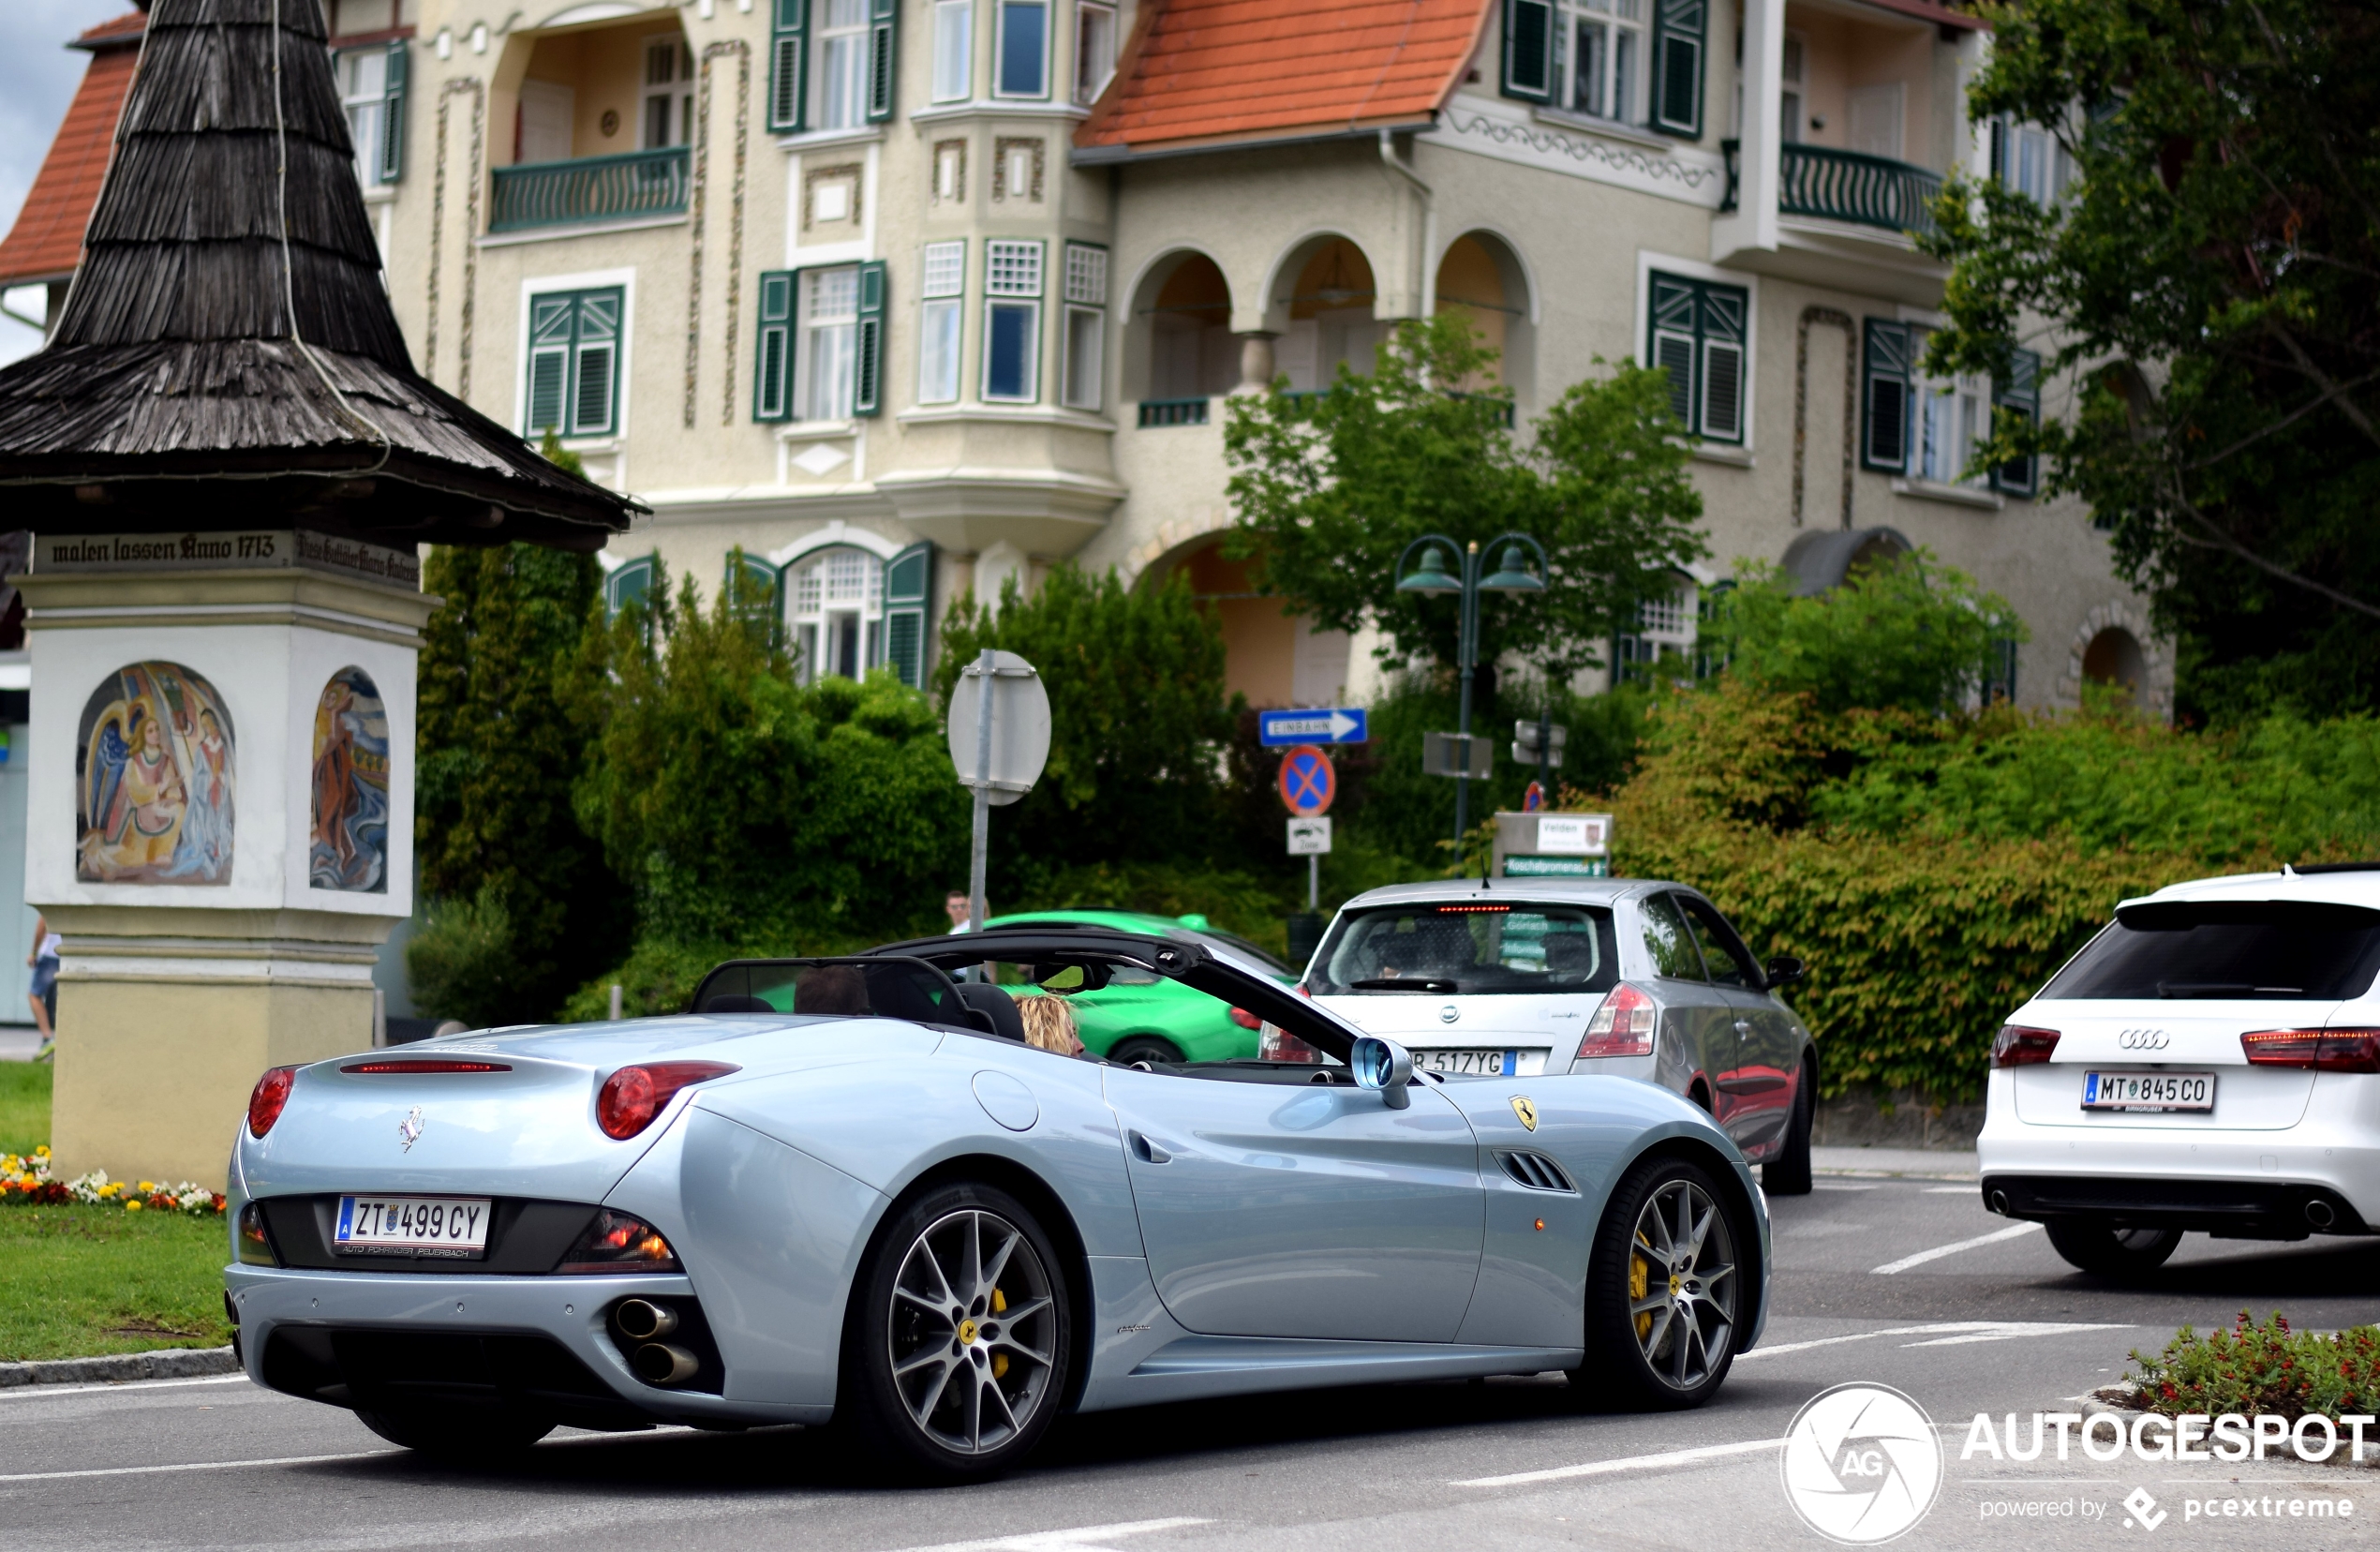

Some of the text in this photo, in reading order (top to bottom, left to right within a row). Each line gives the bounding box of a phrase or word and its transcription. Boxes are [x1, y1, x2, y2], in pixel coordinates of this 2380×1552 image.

[52, 533, 275, 563] malen lassen Anno 1713
[1272, 722, 1331, 734] EINBAHN
[1543, 823, 1577, 833] Velden
[1300, 839, 1319, 850] Zone
[2101, 1078, 2126, 1099] MT
[341, 1203, 480, 1239] A ZT 499 CY
[418, 1247, 469, 1258] PEUERBACH
